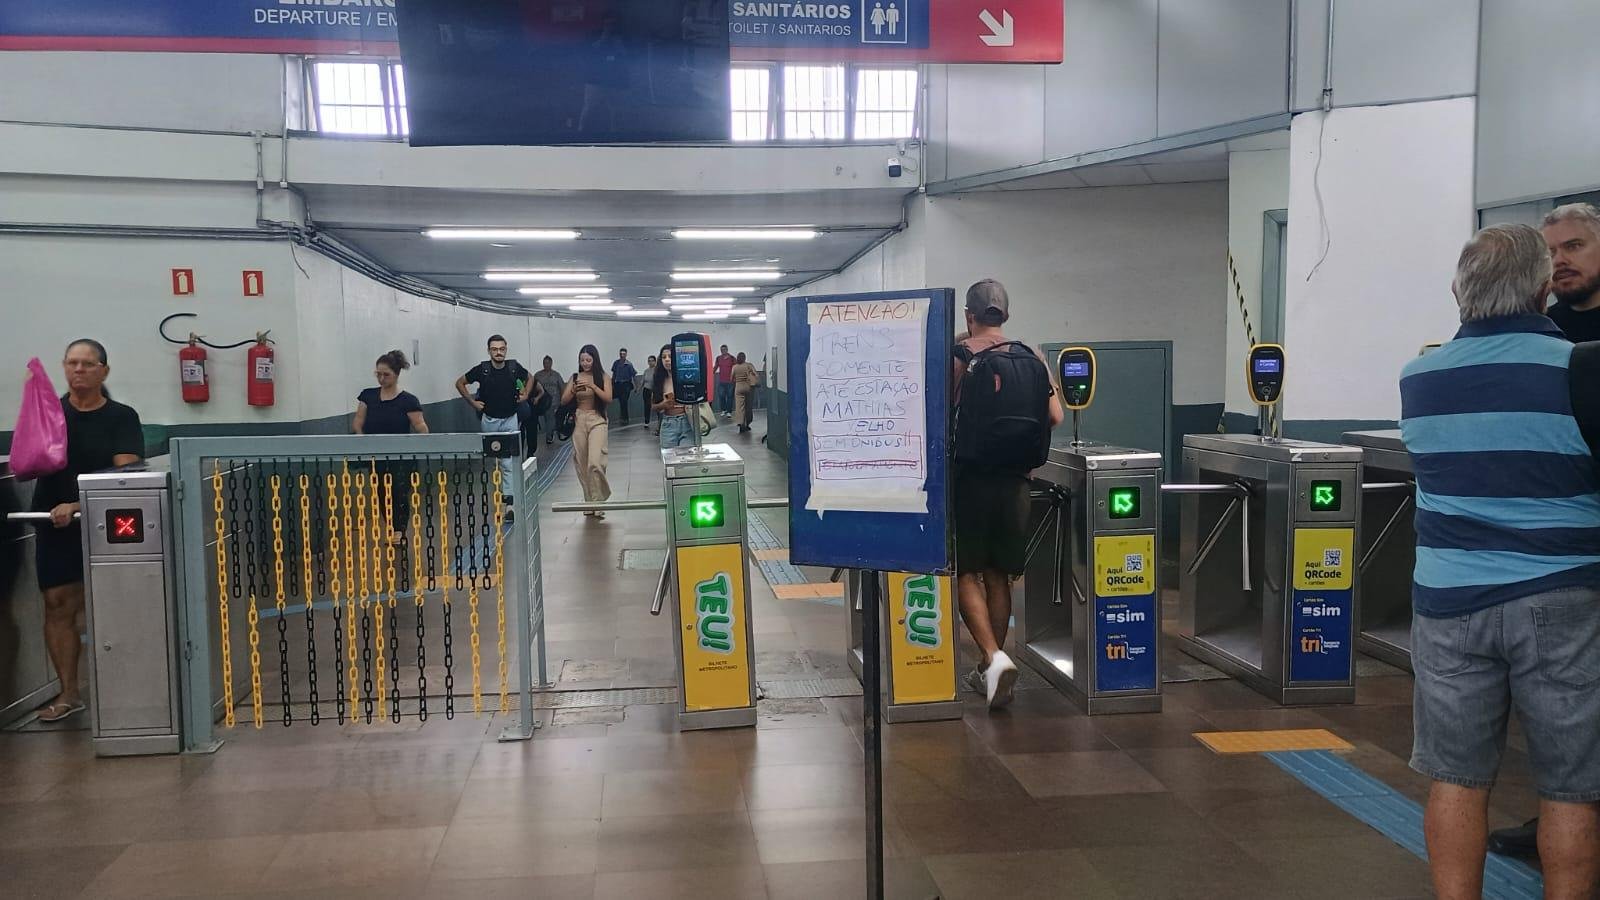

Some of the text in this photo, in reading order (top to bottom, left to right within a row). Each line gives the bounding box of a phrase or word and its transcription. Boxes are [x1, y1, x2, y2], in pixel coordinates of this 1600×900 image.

[254, 8, 361, 25] DEPARTURE
[733, 1, 851, 19] SANITÁRIOS
[778, 23, 851, 36] SANITARIOS
[822, 399, 906, 419] MATHIAS
[1106, 575, 1145, 586] QRCode
[1304, 570, 1342, 579] QRCode
[698, 575, 730, 650] TEU!
[907, 574, 938, 645] TEU!
[1116, 609, 1145, 623] sim
[1312, 603, 1341, 617] sim
